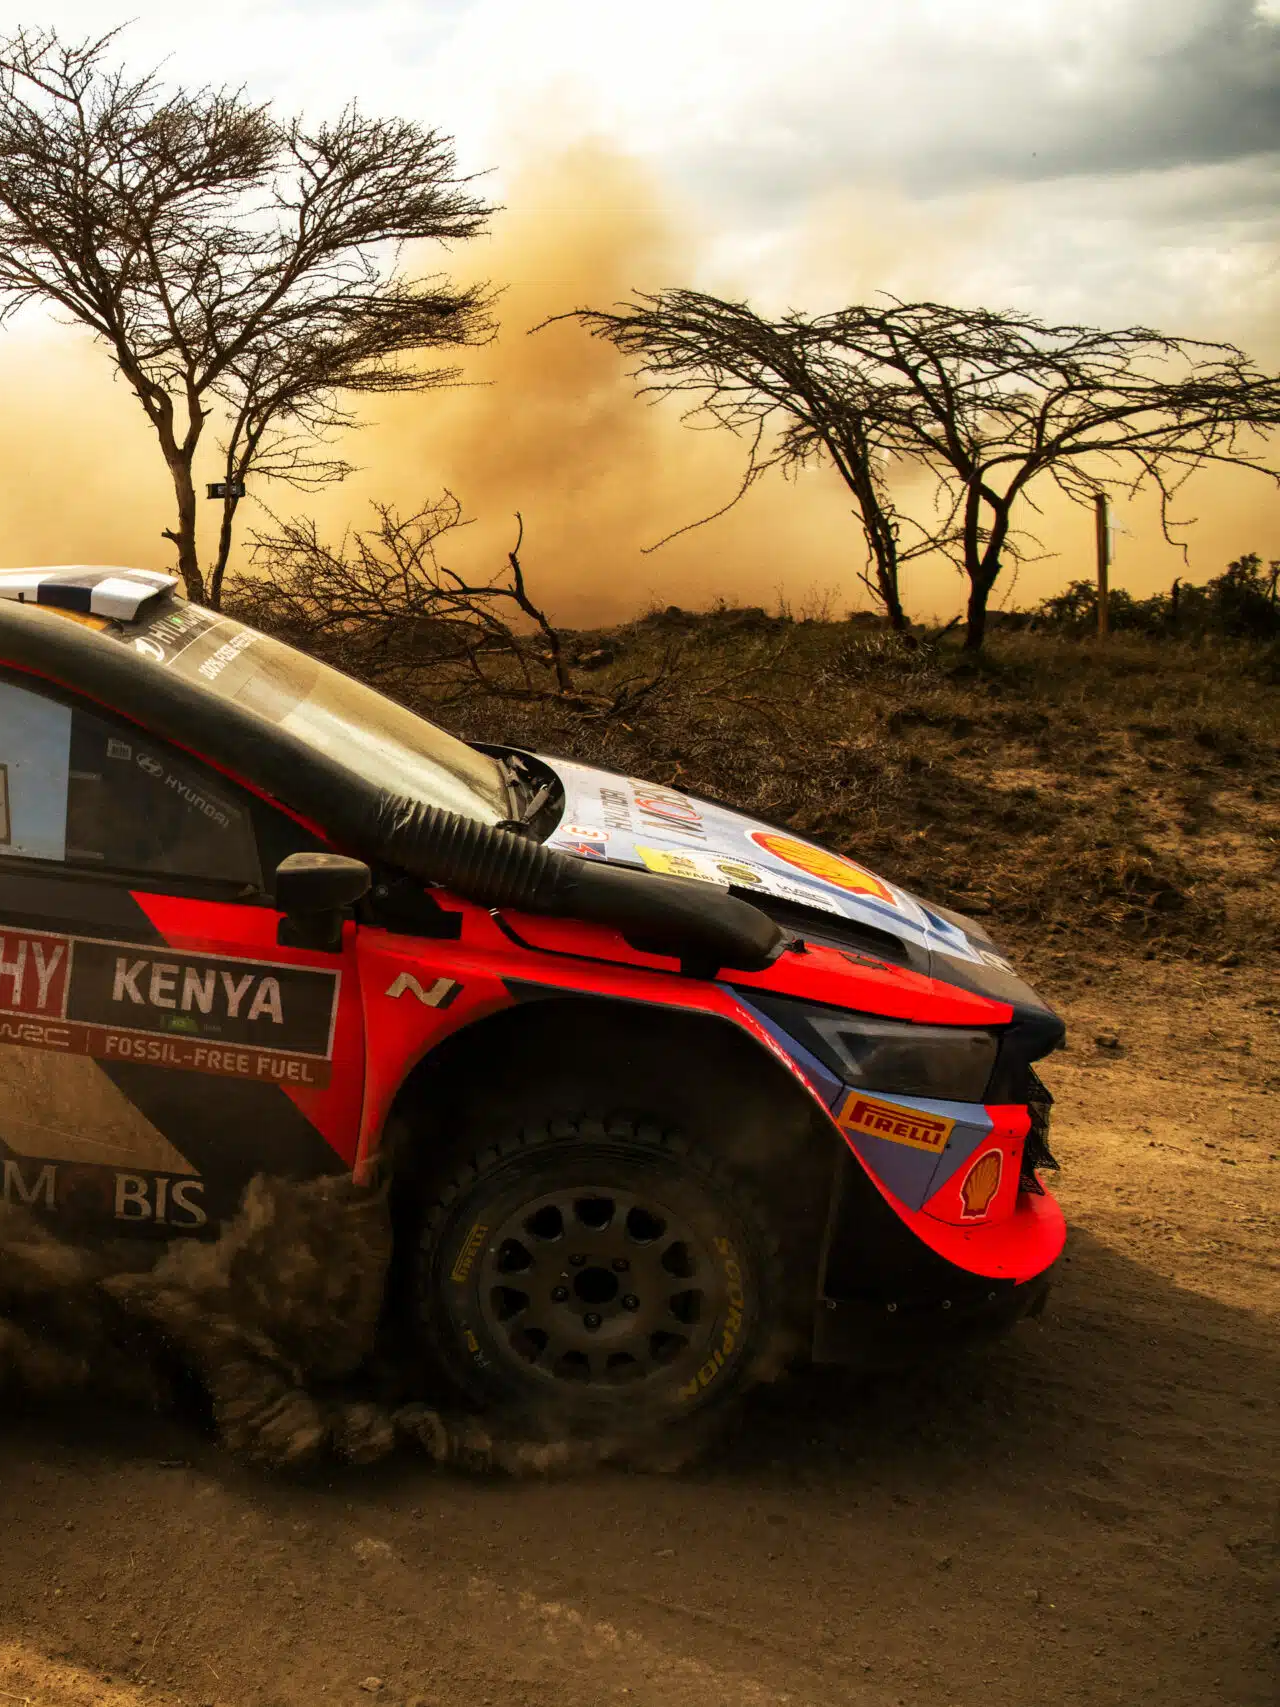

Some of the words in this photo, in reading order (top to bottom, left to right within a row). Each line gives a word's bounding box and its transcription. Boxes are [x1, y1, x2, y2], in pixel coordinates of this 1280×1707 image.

[164, 772, 231, 829] HYUNDAI
[112, 957, 284, 1024] KENYA
[105, 1035, 249, 1074] FOSSIL-FREE
[256, 1056, 315, 1082] FUEL
[849, 1100, 946, 1146] PIRELLI
[448, 1223, 489, 1284] PIRELLI
